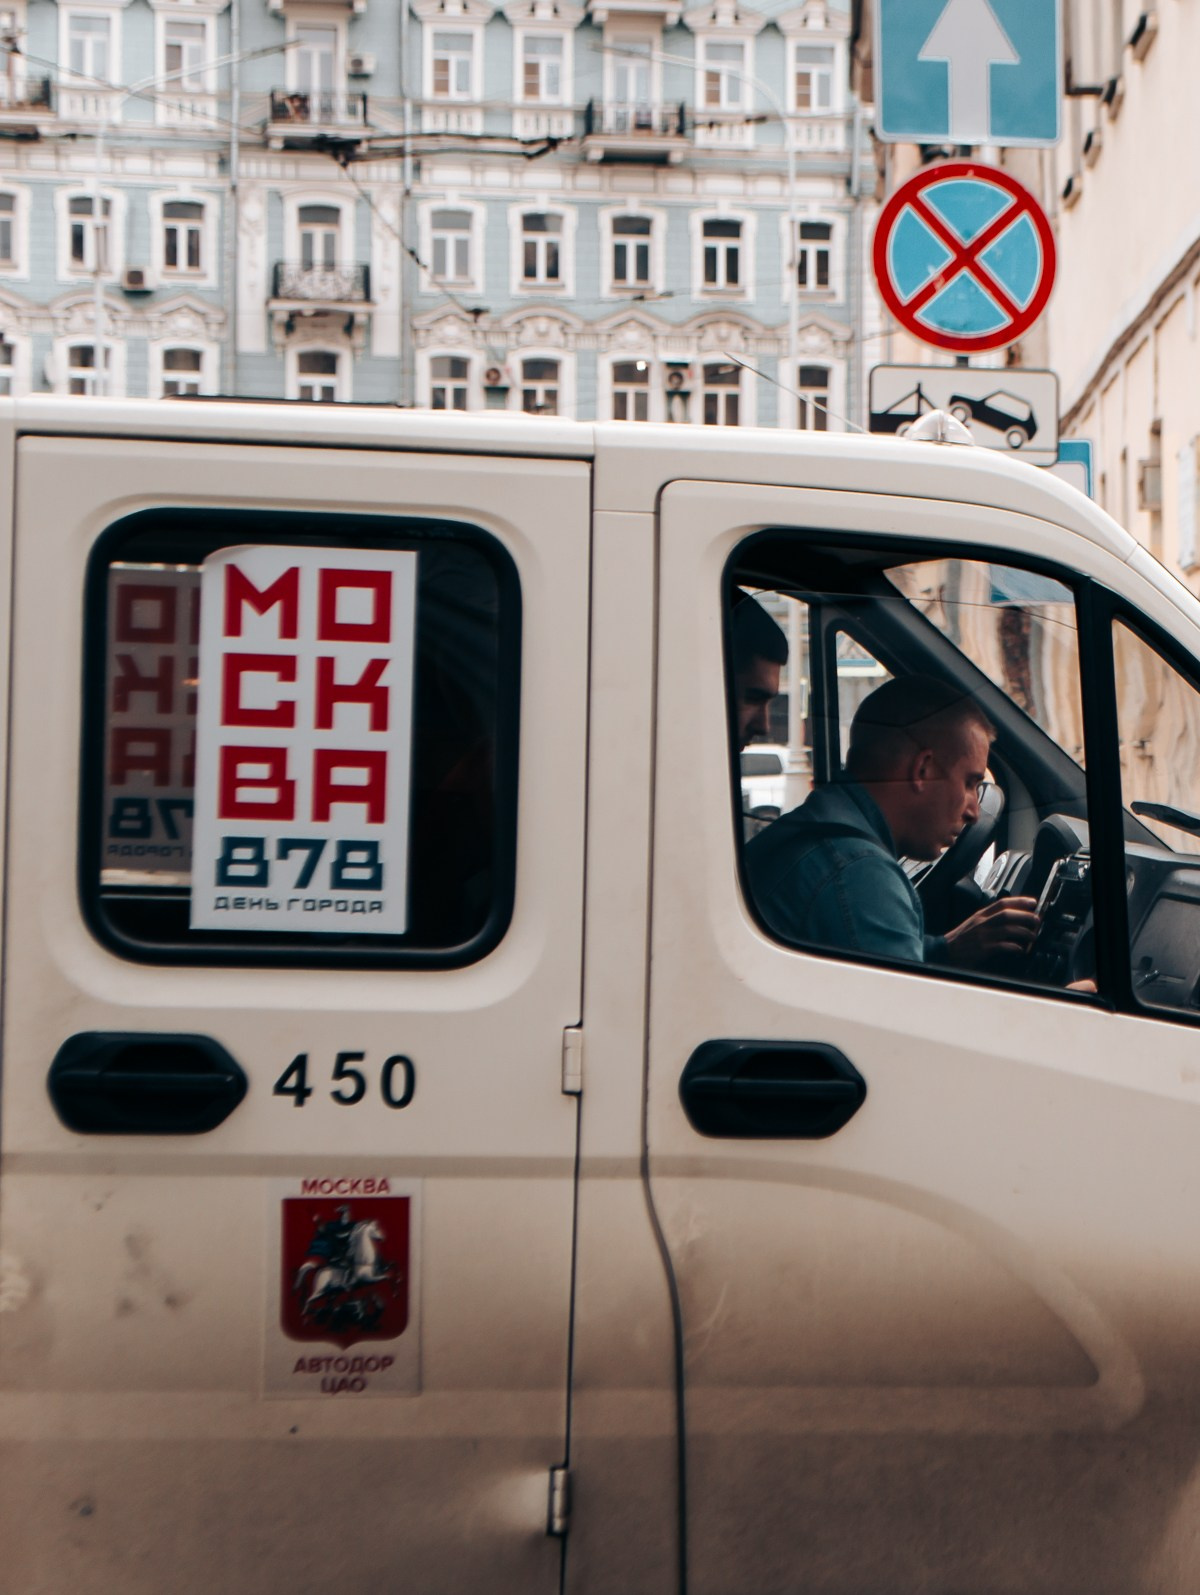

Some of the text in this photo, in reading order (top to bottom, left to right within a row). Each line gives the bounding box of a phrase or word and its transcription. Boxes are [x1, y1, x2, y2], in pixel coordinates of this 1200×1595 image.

[223, 563, 393, 643] МО
[221, 652, 391, 732] СК
[217, 745, 388, 824] ВА
[215, 836, 384, 891] 878
[214, 896, 383, 914] ДЕНЬ ГОРОДА
[272, 1051, 416, 1110] 450
[302, 1178, 390, 1195] МОСКВА
[293, 1355, 394, 1375] АВТОДОР
[320, 1376, 367, 1395] ЦАО
